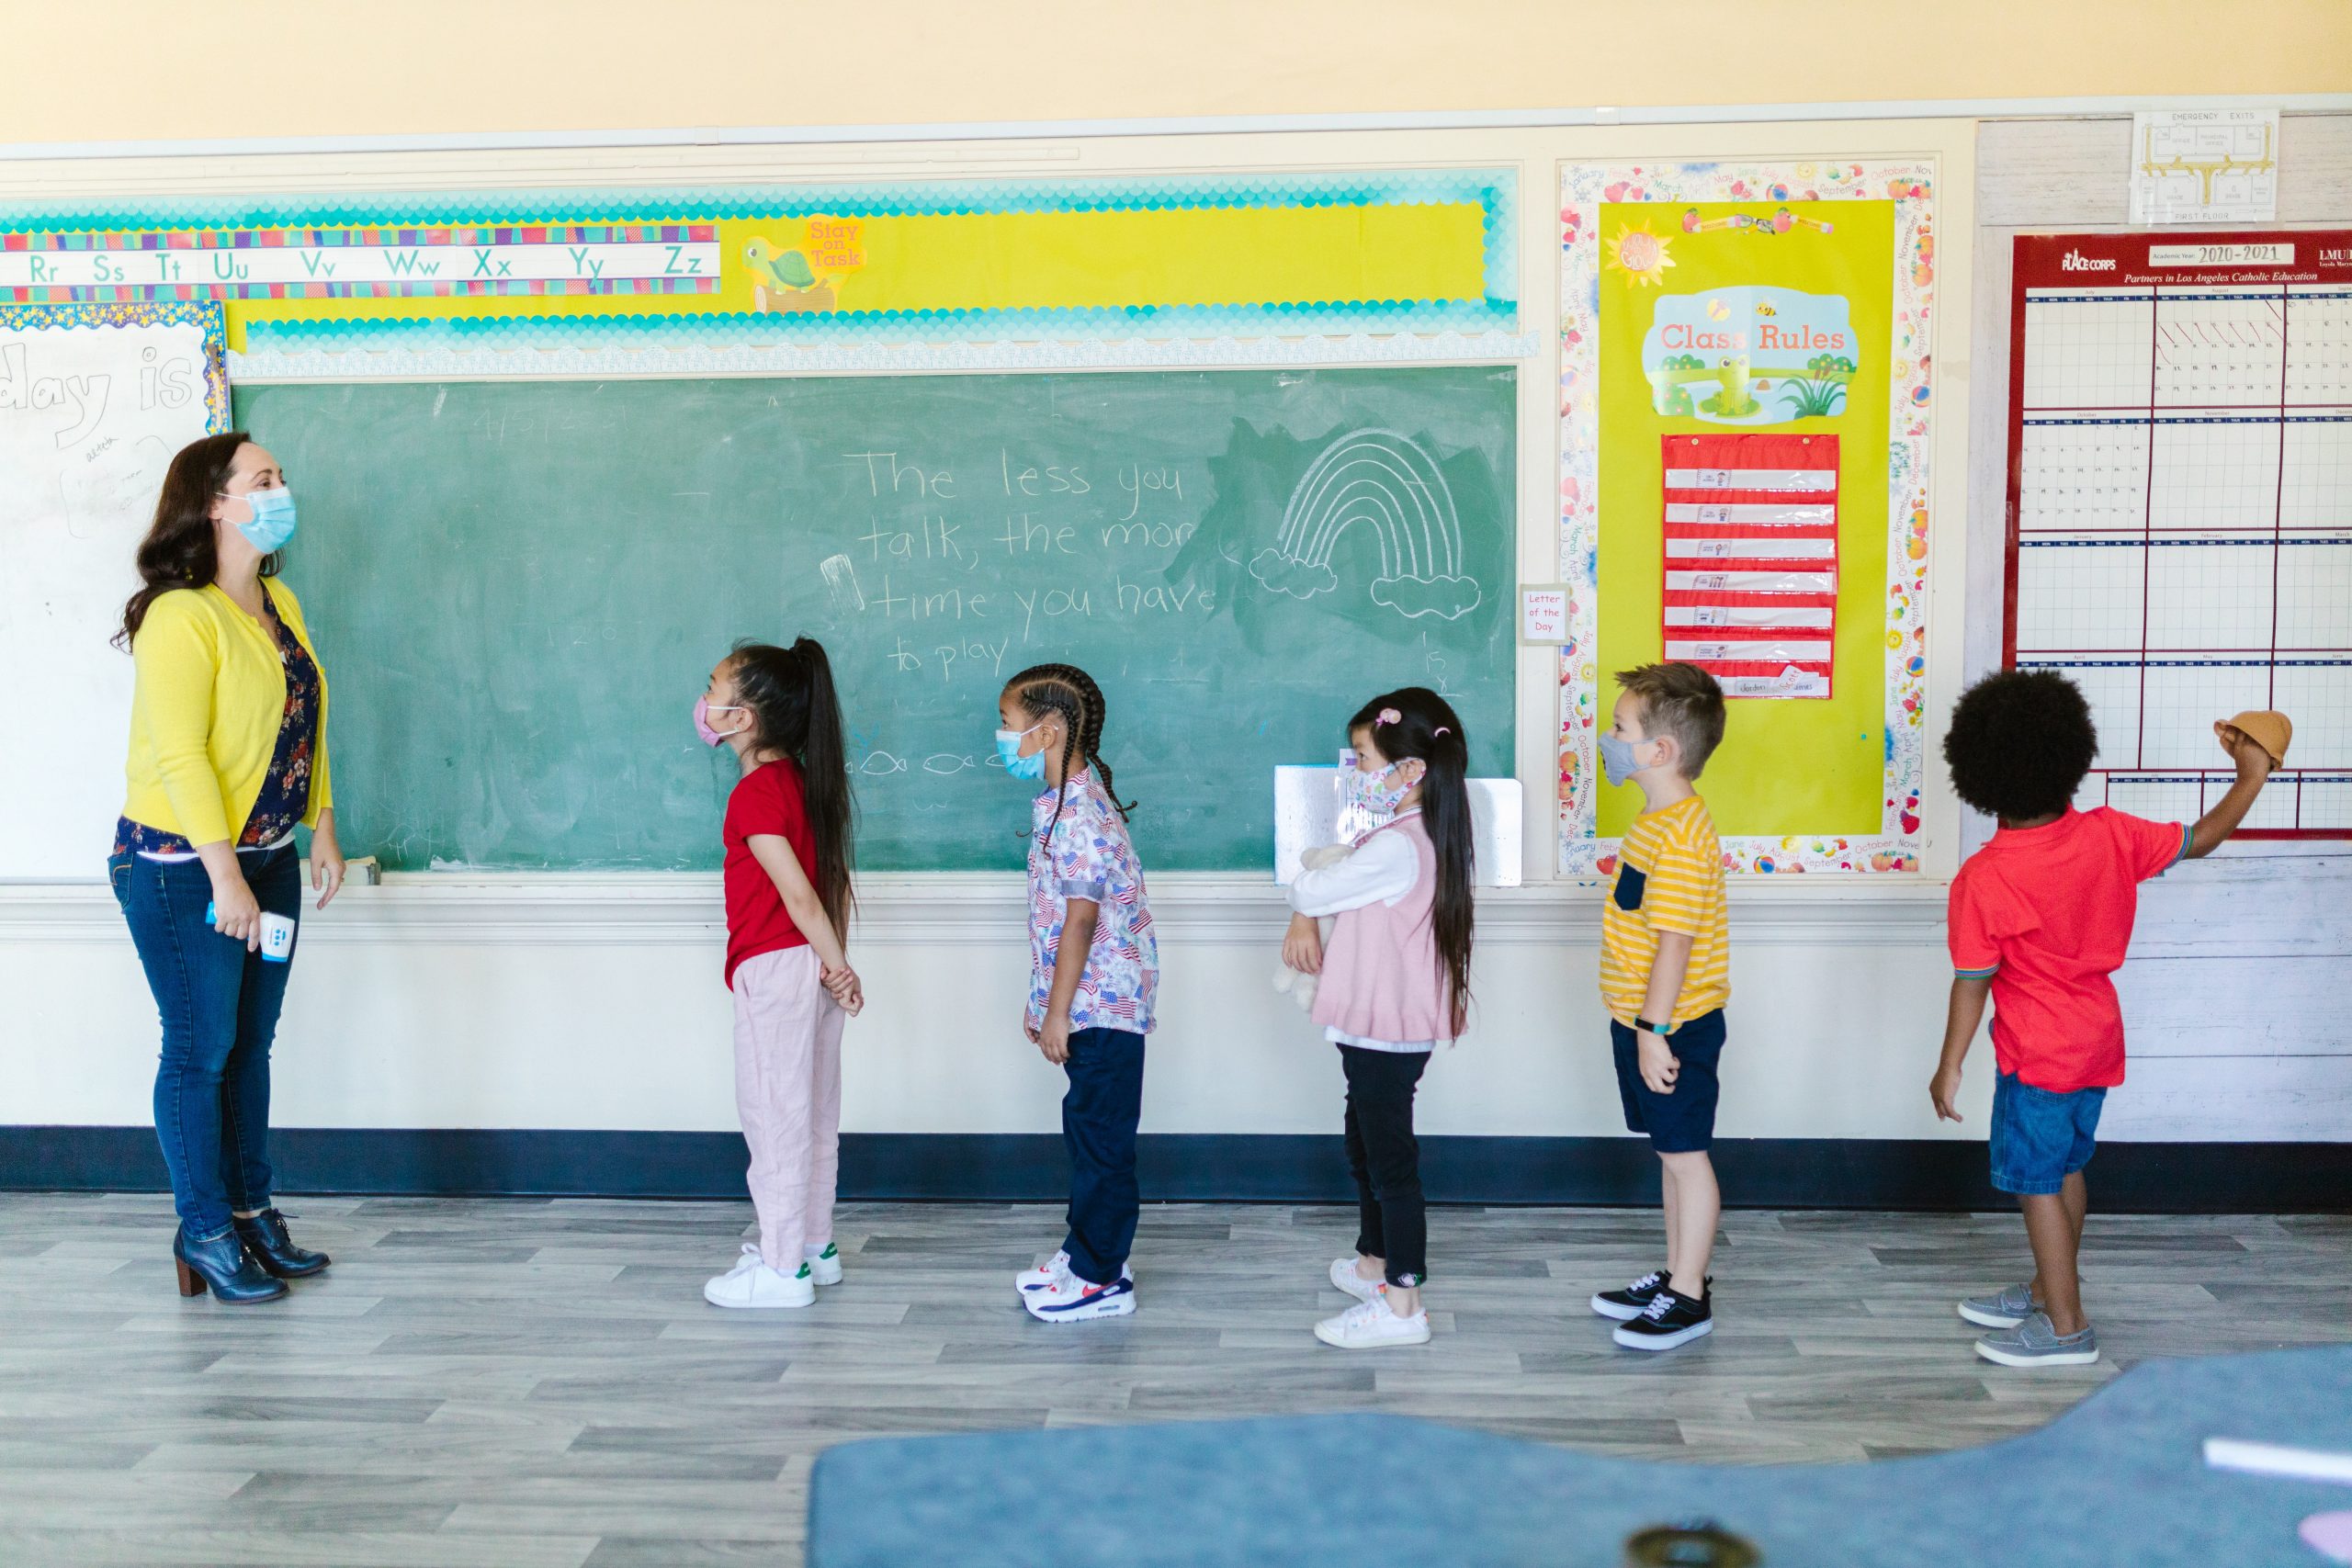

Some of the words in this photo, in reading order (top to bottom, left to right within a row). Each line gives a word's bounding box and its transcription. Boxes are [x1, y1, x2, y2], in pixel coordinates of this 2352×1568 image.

[1569, 169, 1604, 189] January
[1654, 180, 1683, 193] March
[1713, 174, 1734, 185] May
[1818, 178, 1867, 196] September
[1871, 166, 1911, 181] October
[810, 221, 859, 241] Stay
[823, 241, 845, 250] on
[1898, 214, 1919, 260] November
[30, 254, 59, 282] Rr
[94, 254, 125, 282] Ss
[155, 253, 181, 281] Tt
[213, 253, 249, 280] Uu
[300, 250, 336, 277] Vv
[383, 248, 441, 277] Ww
[472, 248, 513, 277] Xx
[568, 246, 605, 288] Yy
[664, 245, 703, 275] Zz
[811, 248, 861, 267] Task
[2062, 250, 2089, 271] PLACE
[2089, 259, 2117, 271] CORPS
[2199, 245, 2280, 264] 2020-2021
[1898, 265, 1913, 304] October
[2124, 274, 2163, 284] Partners
[2165, 274, 2175, 282] in
[2177, 273, 2192, 282] Los
[2194, 273, 2229, 285] Angeles
[2232, 272, 2269, 282] Catholic
[2272, 271, 2318, 281] Education
[1660, 324, 1747, 349] Class
[1758, 323, 1846, 349] Rules
[1910, 308, 1927, 356] September
[141, 346, 192, 411] is
[1909, 439, 1920, 486] December
[842, 448, 956, 499] The
[1002, 447, 1091, 496] less
[1119, 462, 1182, 521] you
[1894, 490, 1912, 533] November
[857, 513, 978, 570] talk,
[992, 513, 1076, 556] the
[1570, 525, 1583, 555] March
[1568, 559, 1581, 581] April
[1894, 537, 1908, 577] October
[871, 573, 989, 621] time
[1013, 588, 1091, 642] you
[1116, 574, 1216, 615] have
[1529, 594, 1561, 604] Letter
[1529, 607, 1541, 617] of
[1544, 607, 1559, 617] the
[1905, 581, 1920, 627] September
[1535, 622, 1554, 633] Day
[1579, 630, 1594, 648] July
[888, 636, 922, 671] to
[935, 636, 1008, 682] play
[1899, 631, 1913, 662] August
[1571, 651, 1589, 681] August
[1893, 662, 1904, 682] July
[1564, 685, 1580, 732] September
[1896, 710, 1907, 729] May
[1577, 736, 1591, 773] October
[1903, 732, 1914, 752] April
[1900, 758, 1913, 788] March
[1572, 777, 1592, 821] November
[1887, 791, 1906, 830] February
[1748, 840, 1766, 854] July
[1770, 847, 1801, 862] August
[1804, 852, 1852, 869] September
[1855, 840, 1894, 853] October
